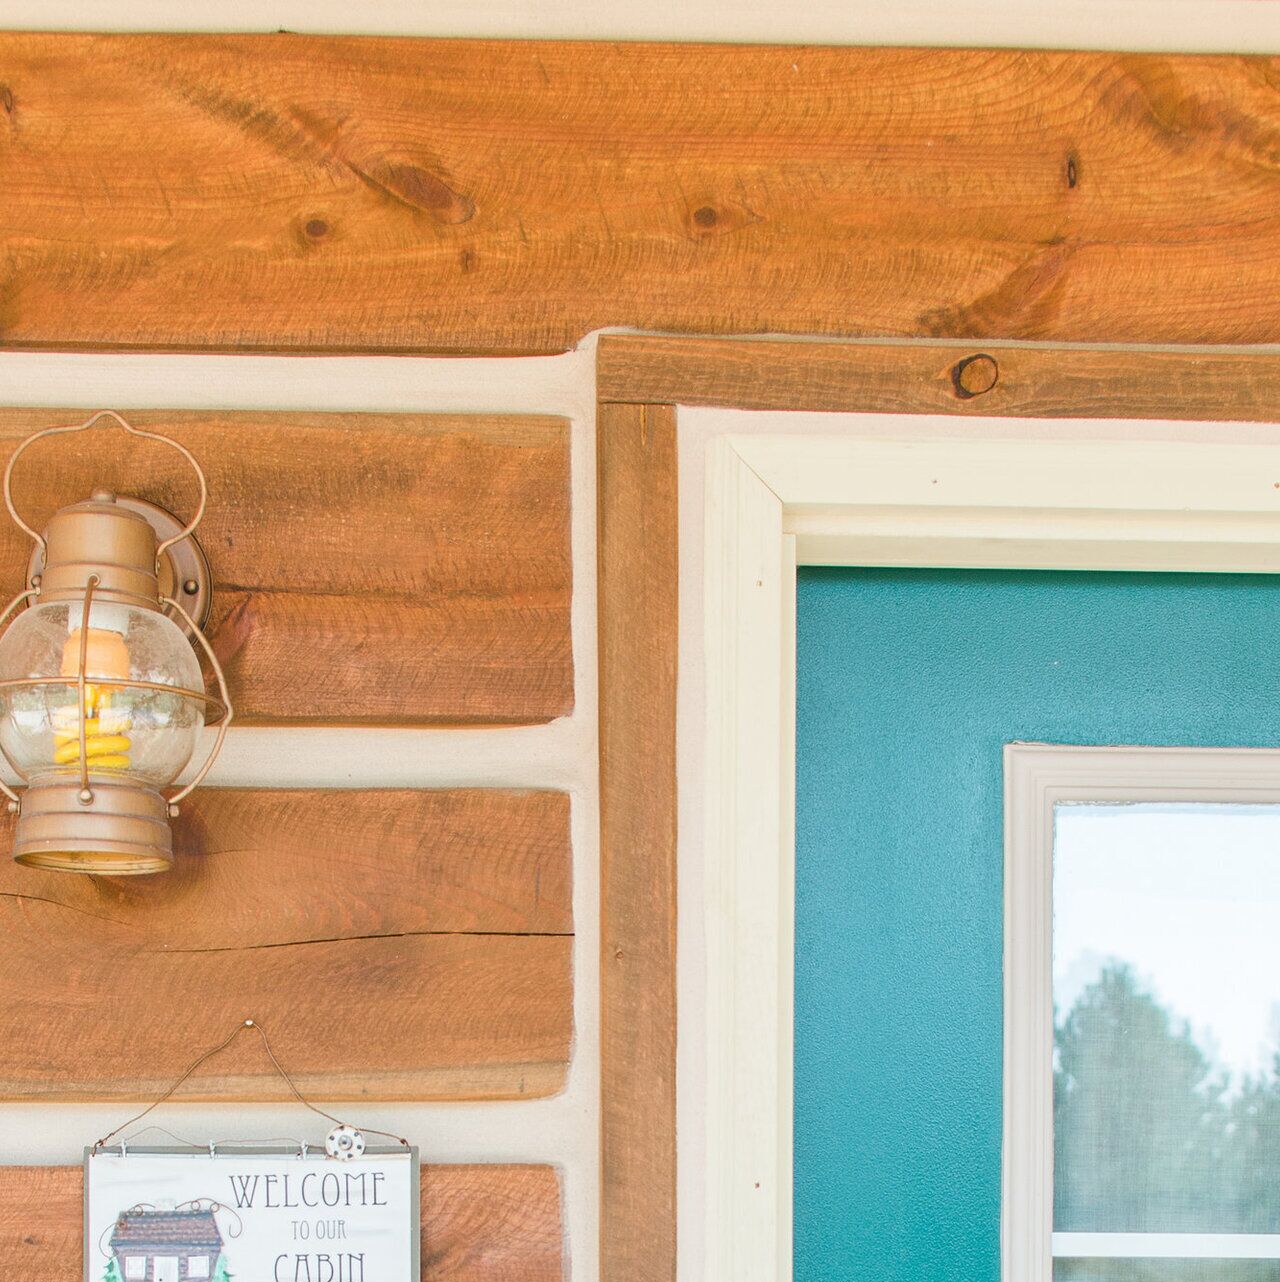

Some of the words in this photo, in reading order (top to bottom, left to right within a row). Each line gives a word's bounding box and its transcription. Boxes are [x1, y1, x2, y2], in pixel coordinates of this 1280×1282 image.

[229, 1172, 387, 1208] WELCOME
[291, 1220, 309, 1240] TO
[317, 1219, 346, 1239] OUR
